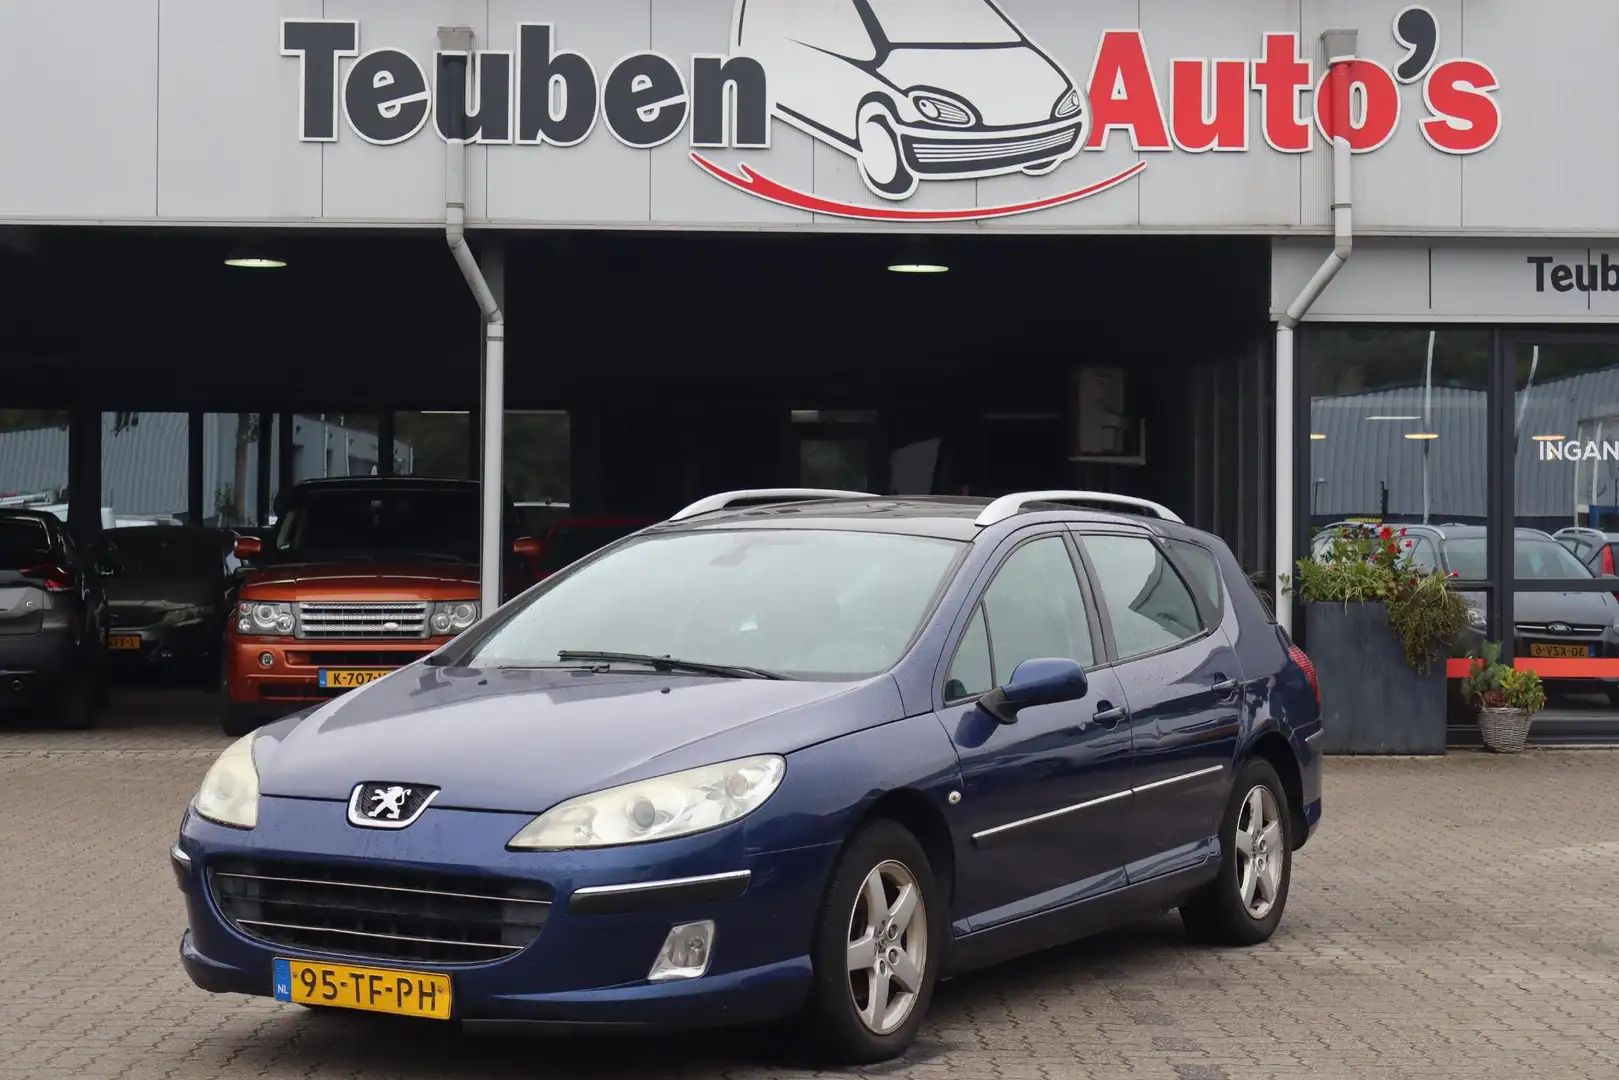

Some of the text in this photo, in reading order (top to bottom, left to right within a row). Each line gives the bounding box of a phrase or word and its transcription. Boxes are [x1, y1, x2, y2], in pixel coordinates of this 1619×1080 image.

[280, 5, 1502, 154] Teuben Auto's
[1527, 254, 1619, 292] Teub
[1539, 440, 1619, 461] INGAN
[333, 673, 386, 685] K-707-
[277, 967, 436, 1011] NL 95-TF-PH
